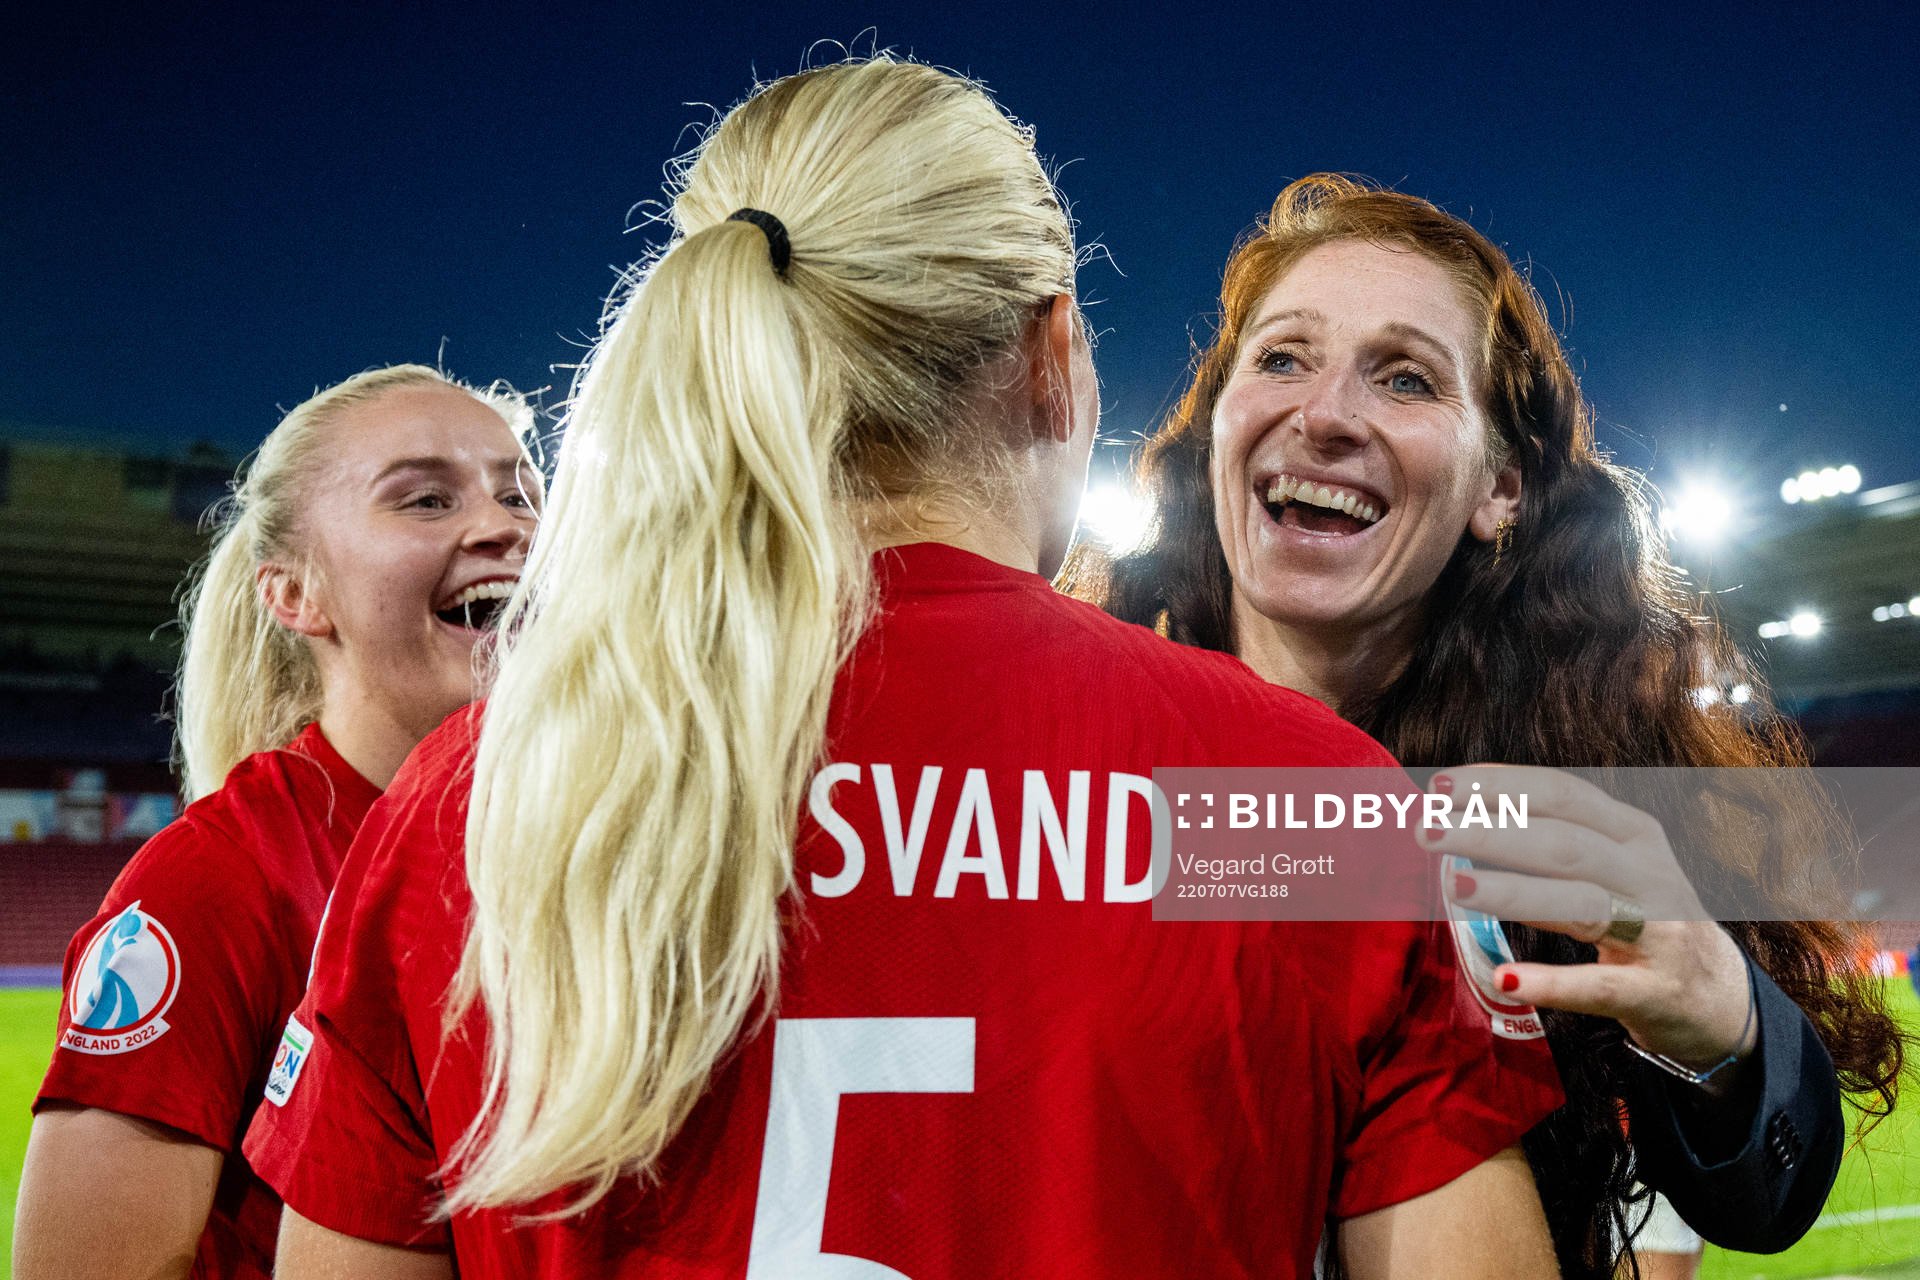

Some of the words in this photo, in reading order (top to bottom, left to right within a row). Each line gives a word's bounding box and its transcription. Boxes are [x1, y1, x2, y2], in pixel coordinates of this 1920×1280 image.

[809, 762, 1173, 903] SVAND
[124, 1025, 159, 1047] 2022
[746, 1017, 976, 1280] 5
